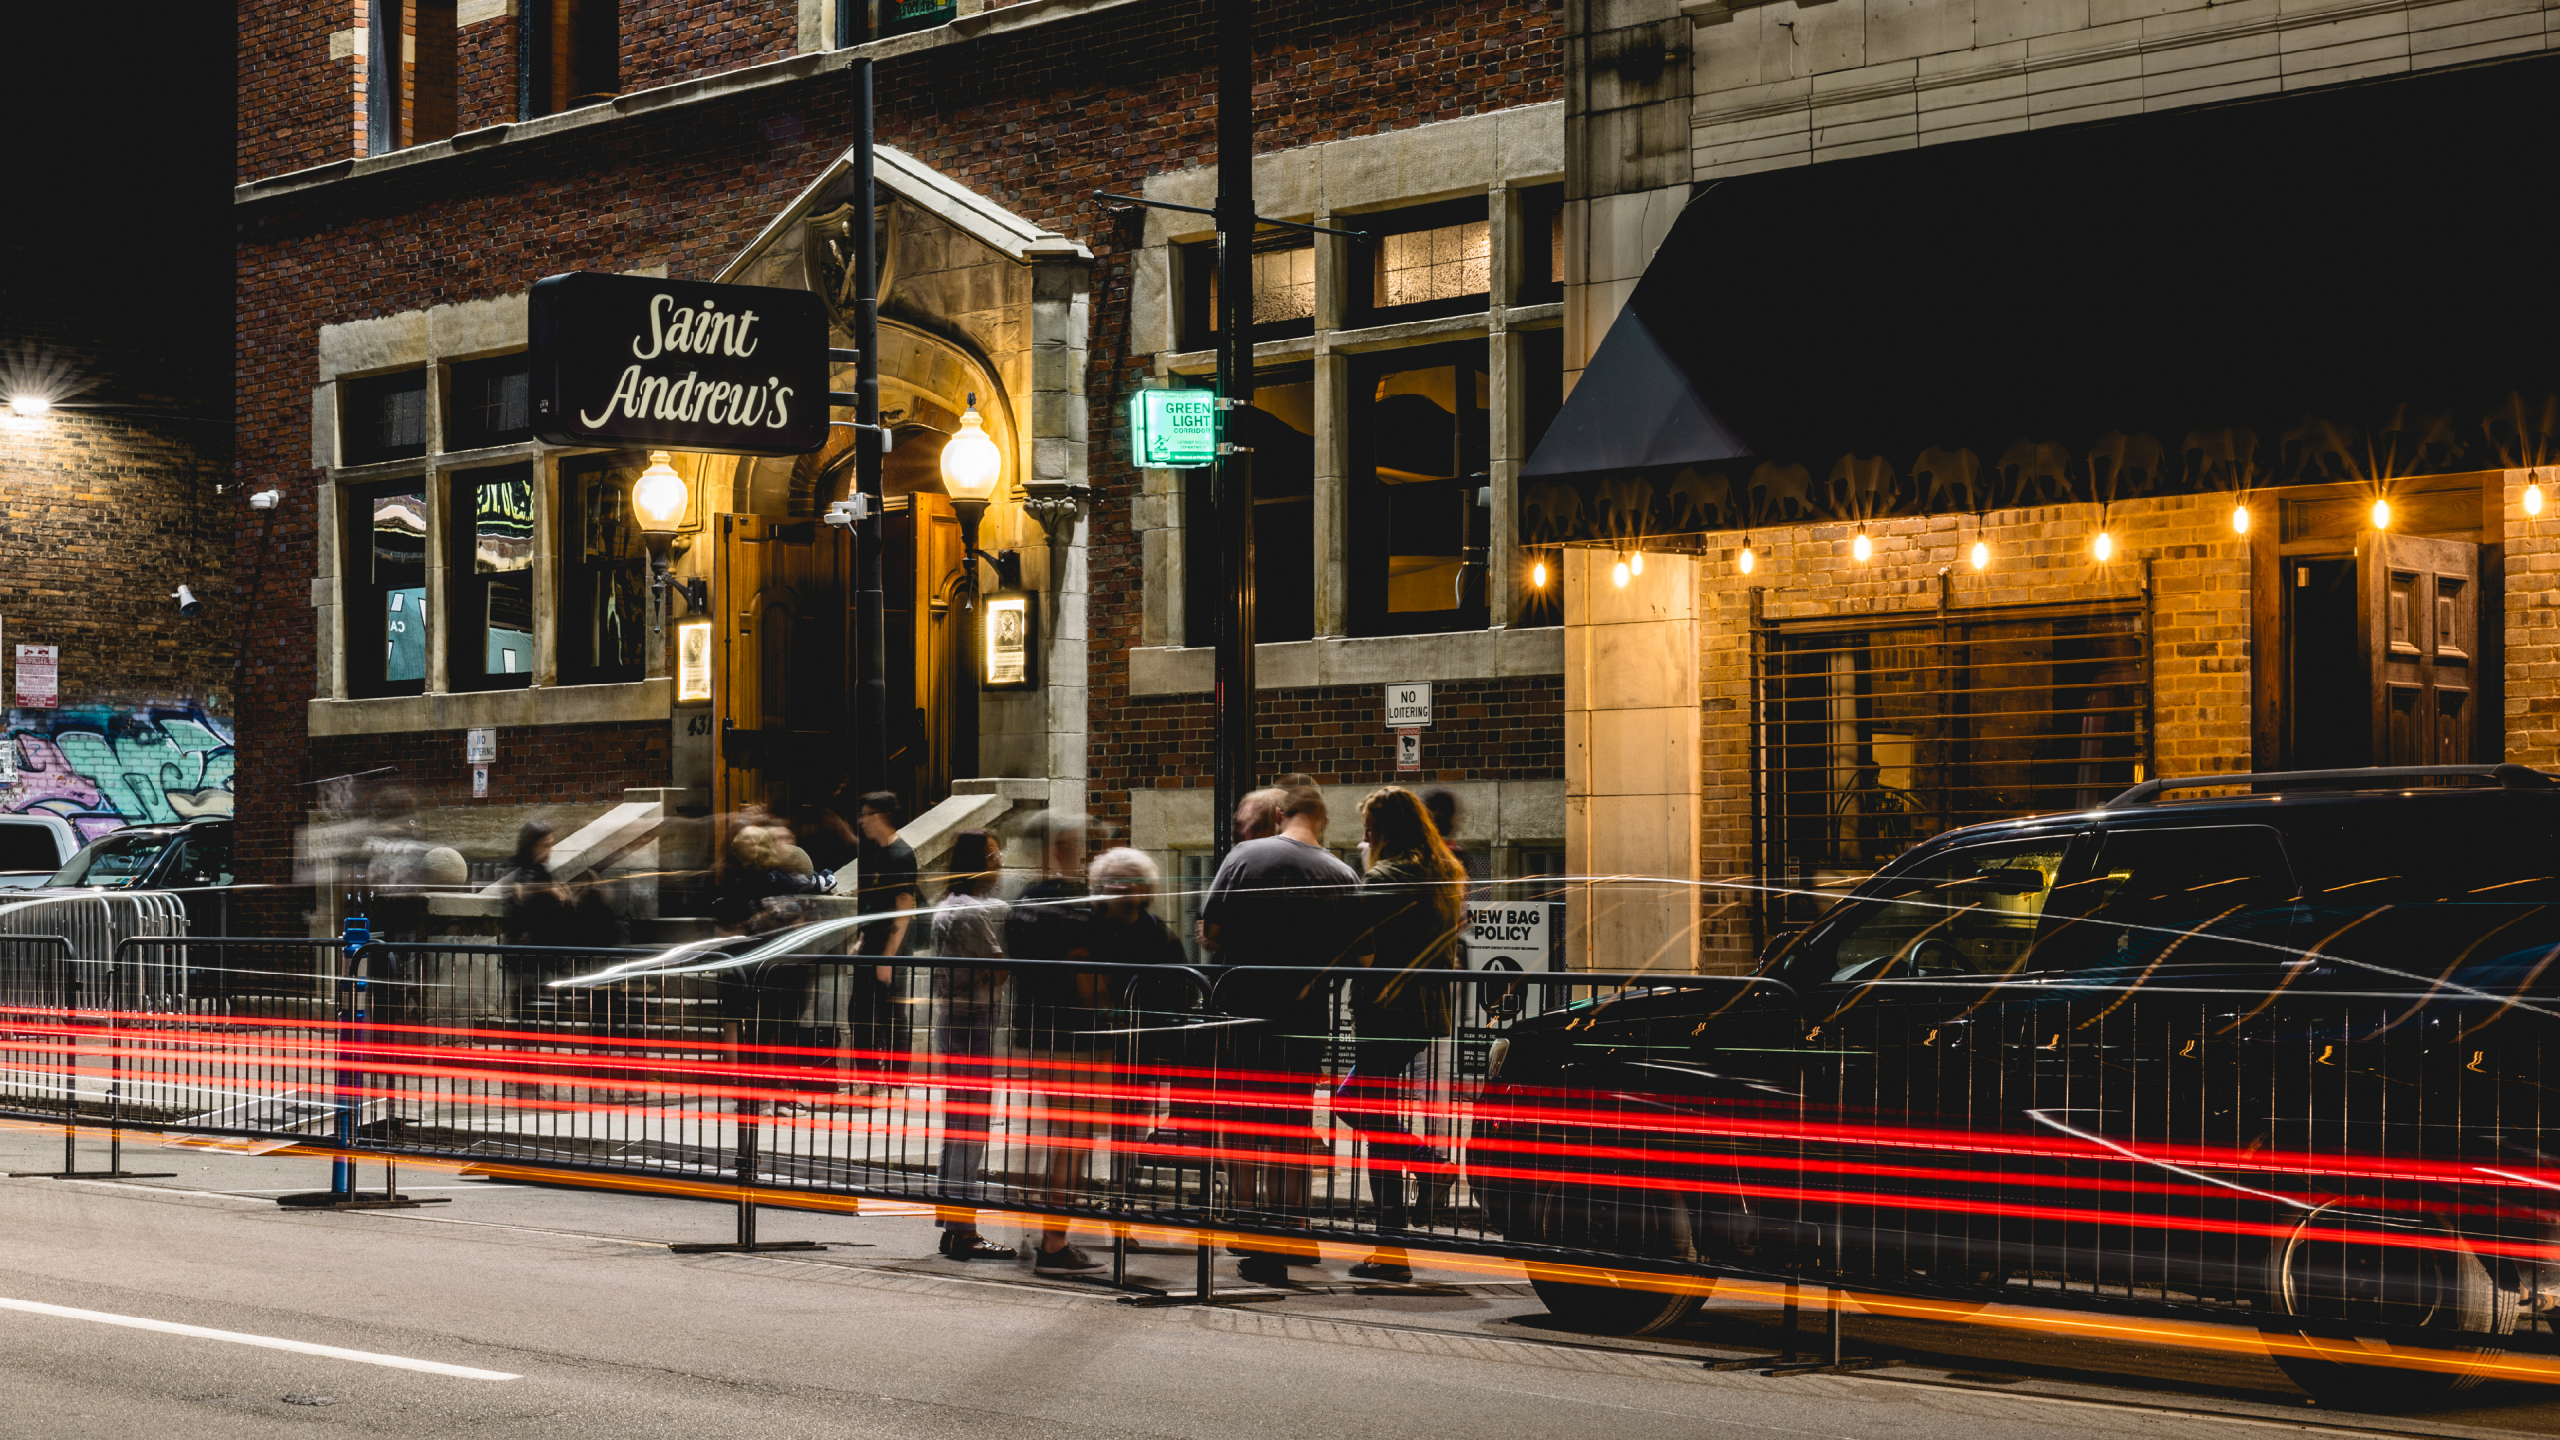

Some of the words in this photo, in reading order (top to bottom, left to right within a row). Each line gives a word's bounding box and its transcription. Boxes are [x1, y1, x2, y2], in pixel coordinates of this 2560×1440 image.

[632, 293, 760, 360] Saint
[580, 364, 794, 430] Andrew's
[1165, 402, 1211, 414] GREEN
[1172, 415, 1211, 427] LIGHT
[1401, 690, 1416, 704] NO
[1389, 706, 1428, 719] LOITERING
[687, 714, 712, 737] 431
[476, 735, 486, 745] NO
[469, 747, 494, 757] LOTERING
[1466, 909, 1503, 924] NEW
[1507, 910, 1540, 925] BAG
[1474, 926, 1532, 941] POLICY
